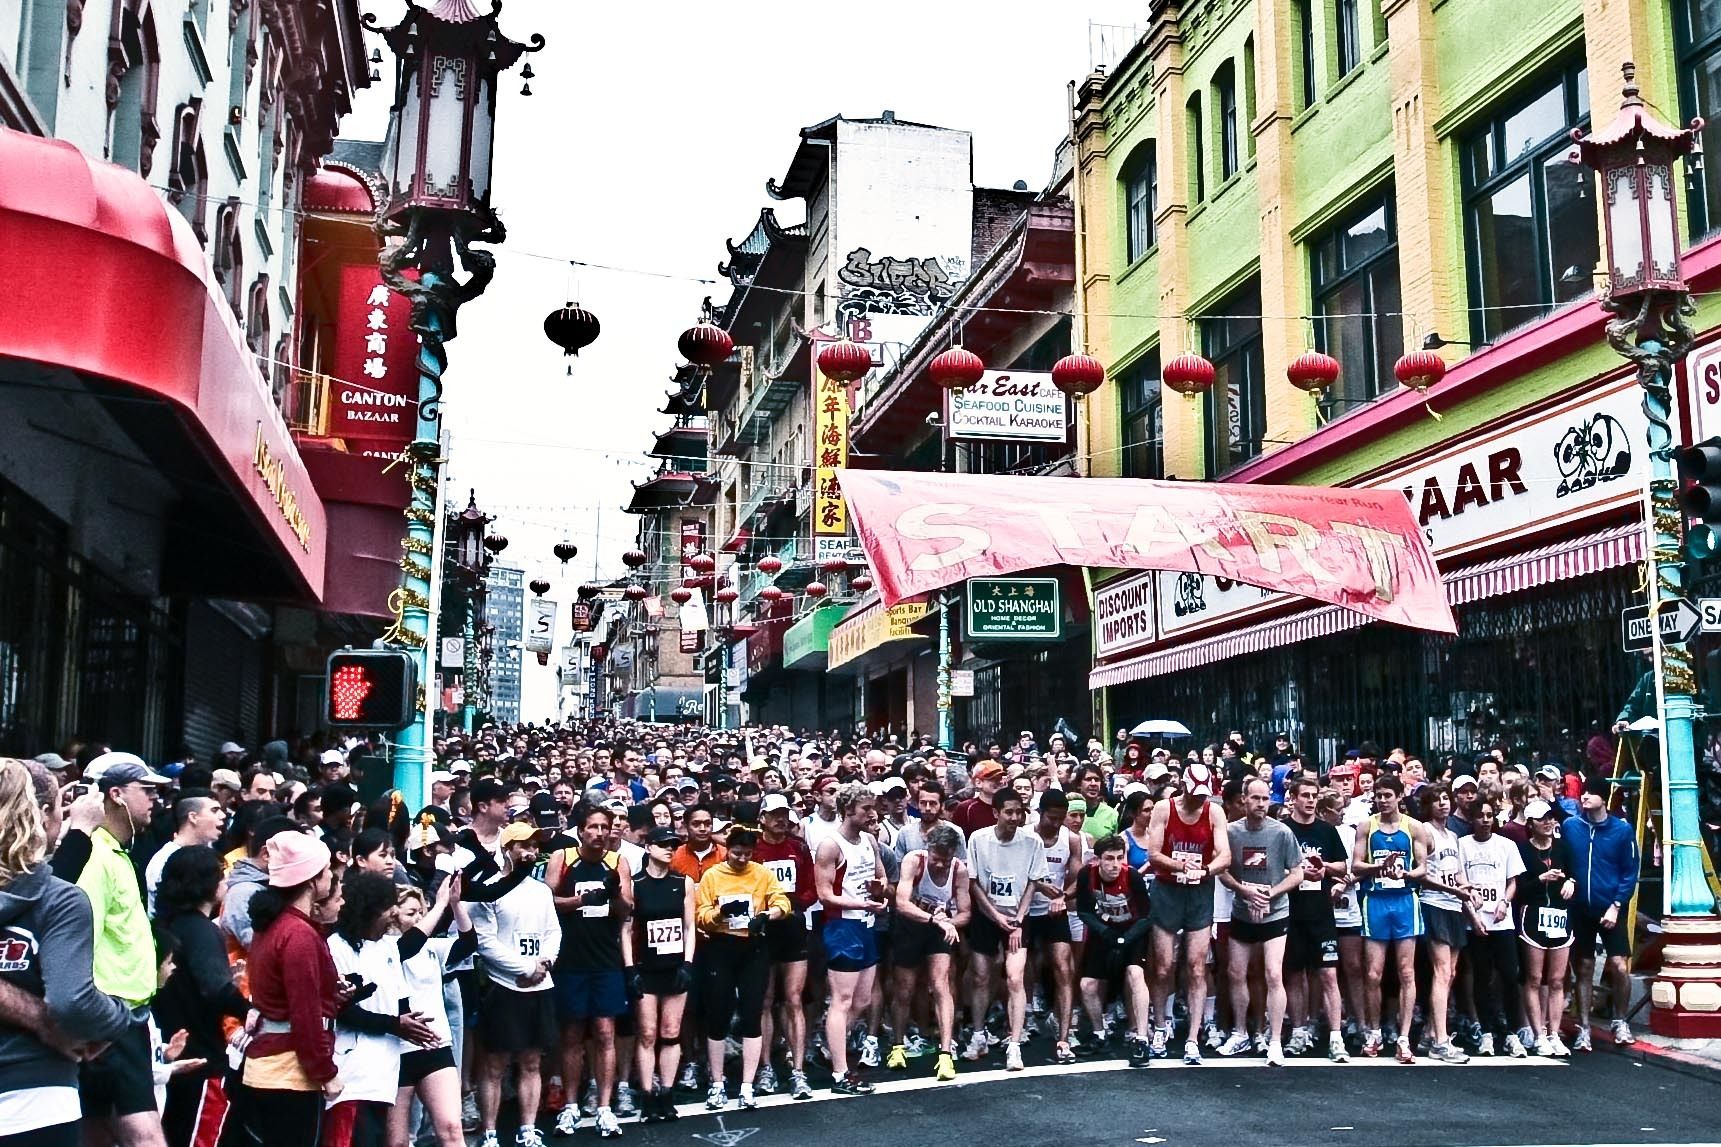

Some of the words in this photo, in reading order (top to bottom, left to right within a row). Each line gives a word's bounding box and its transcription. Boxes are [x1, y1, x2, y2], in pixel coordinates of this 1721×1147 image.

[992, 375, 1041, 397] East
[1040, 388, 1063, 399] CAFE
[341, 390, 407, 407] CANTON
[1014, 398, 1063, 415] CUISINE
[347, 410, 399, 423] BAZAAR
[1009, 413, 1063, 430] KARAOKE
[1402, 446, 1529, 527] AAR
[1351, 497, 1385, 511] Run
[895, 498, 1410, 604] START
[908, 604, 922, 615] Bar
[973, 599, 996, 613] OLD
[998, 599, 1054, 614] SHANGHAI
[1098, 581, 1149, 620] DISCOUNT
[1102, 610, 1148, 645] IMPORTS
[1630, 618, 1653, 638] ONE
[648, 925, 682, 944] 1275
[519, 938, 541, 957] 539
